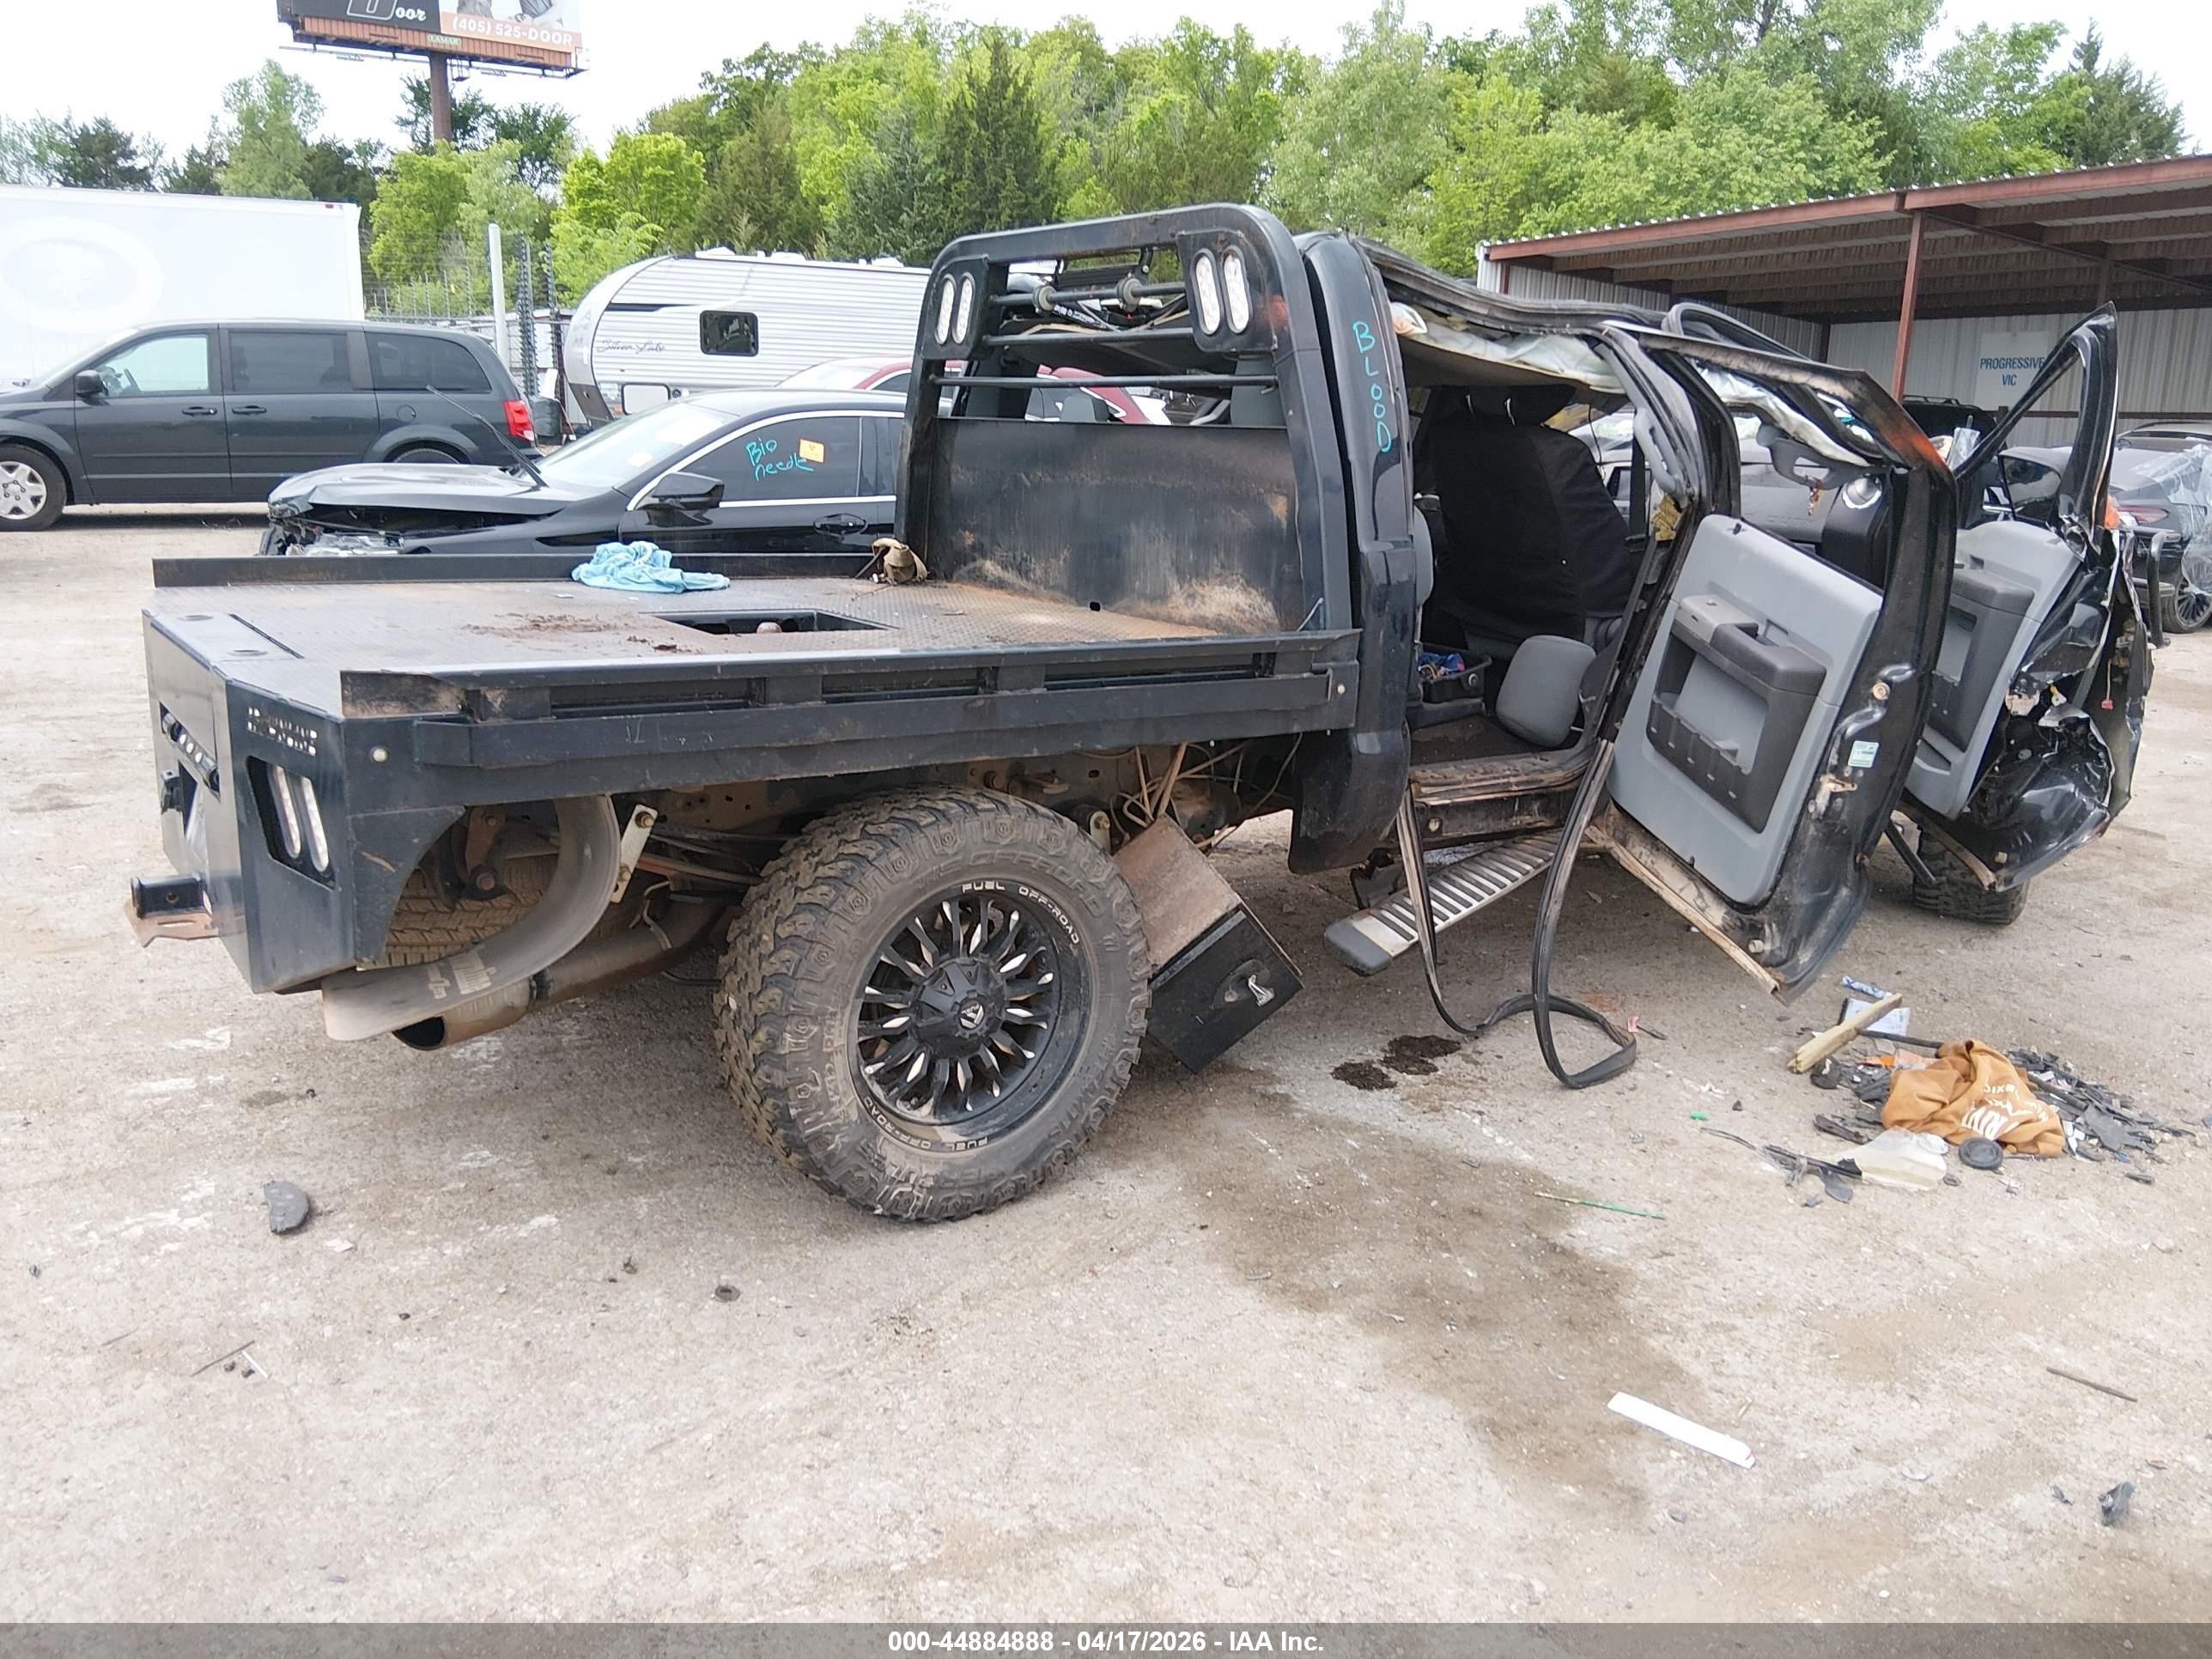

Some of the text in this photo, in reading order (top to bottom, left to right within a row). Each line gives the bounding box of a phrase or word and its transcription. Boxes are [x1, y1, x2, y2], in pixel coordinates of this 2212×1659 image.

[453, 16, 573, 46] (405) 525-DOOR
[1979, 357, 2045, 370] PROGRESSIVE
[1352, 320, 1392, 453] BLOOD
[2002, 374, 2018, 386] VIC
[745, 436, 778, 466] Bio
[962, 880, 1080, 945] FUEL OFF-ROAD
[863, 1096, 989, 1152] FUEL OFF-ROAD
